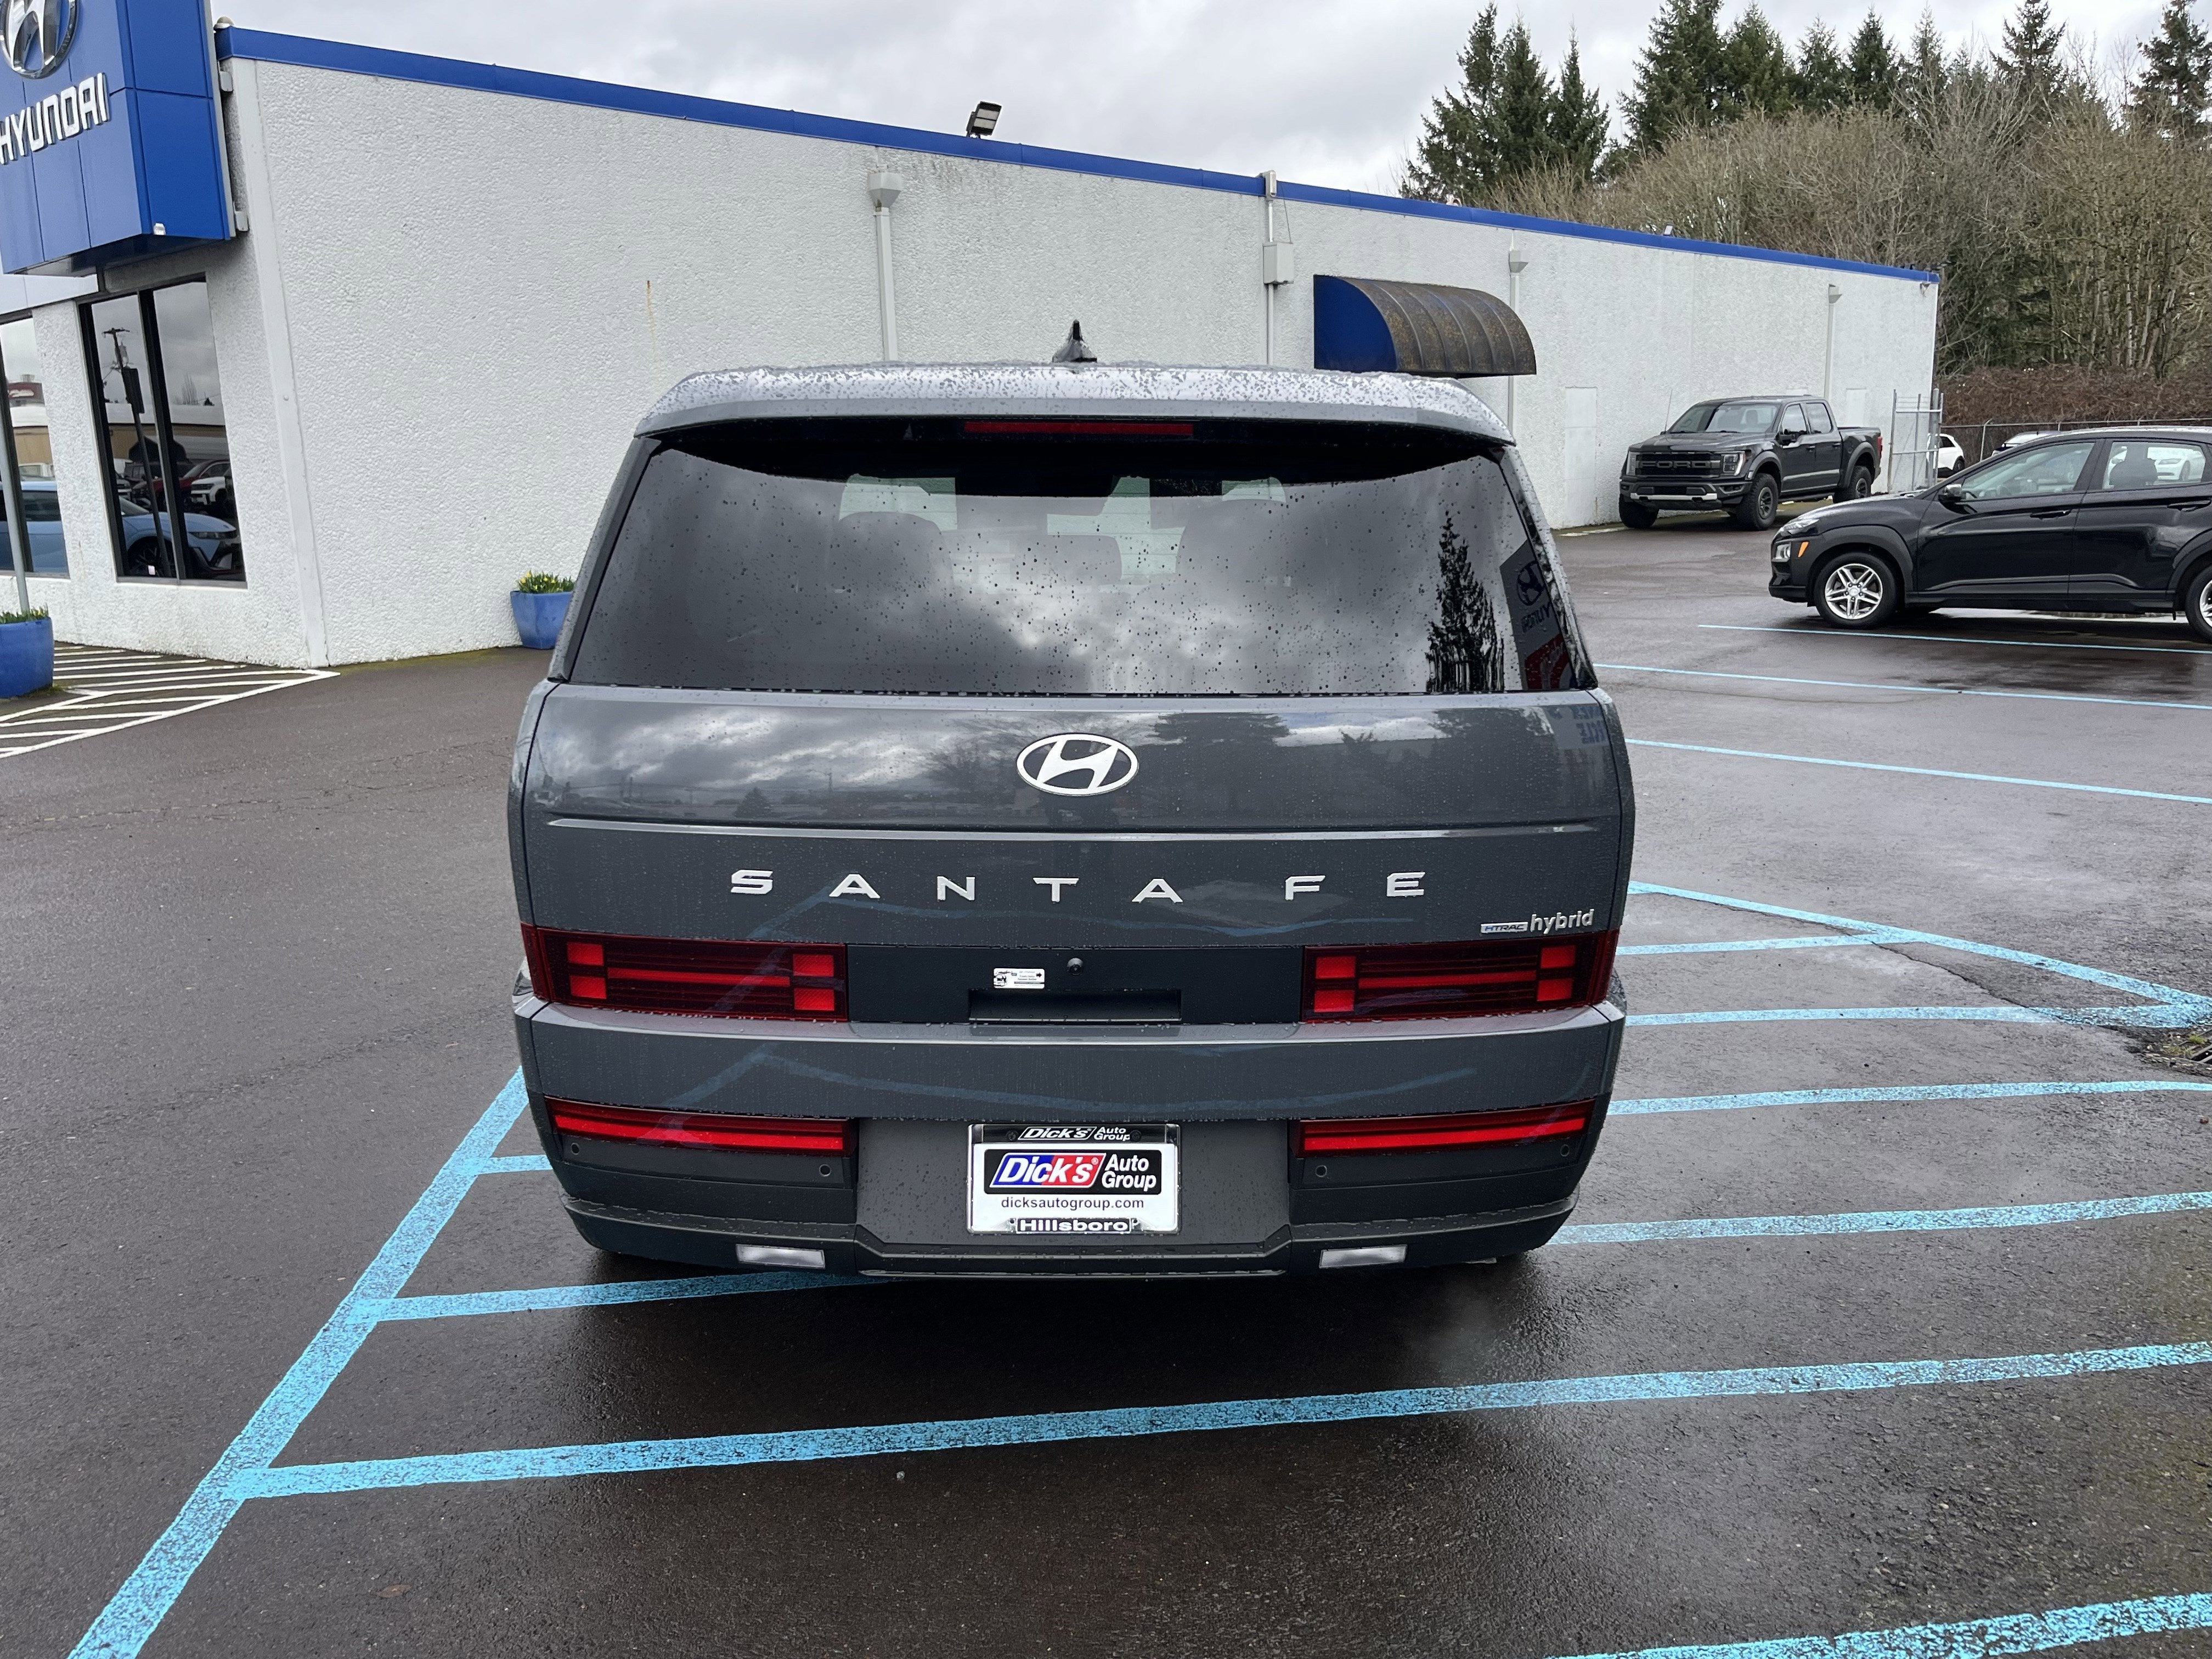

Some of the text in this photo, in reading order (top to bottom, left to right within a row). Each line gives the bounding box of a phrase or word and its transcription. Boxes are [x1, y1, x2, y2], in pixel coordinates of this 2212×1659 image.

[0, 72, 110, 165] HYUNDAI
[1639, 460, 1711, 469] FORD
[731, 869, 1425, 902] SANTA FE
[1485, 909, 1594, 934] HTRAC hybrid
[1024, 1128, 1088, 1138] Dick's
[1094, 1133, 1130, 1142] Group
[998, 1154, 1149, 1183] Dick's Auto
[1102, 1171, 1156, 1192] Group
[1001, 1197, 1144, 1211] dicksautogroup.com
[1019, 1220, 1128, 1232] Hillsboro
